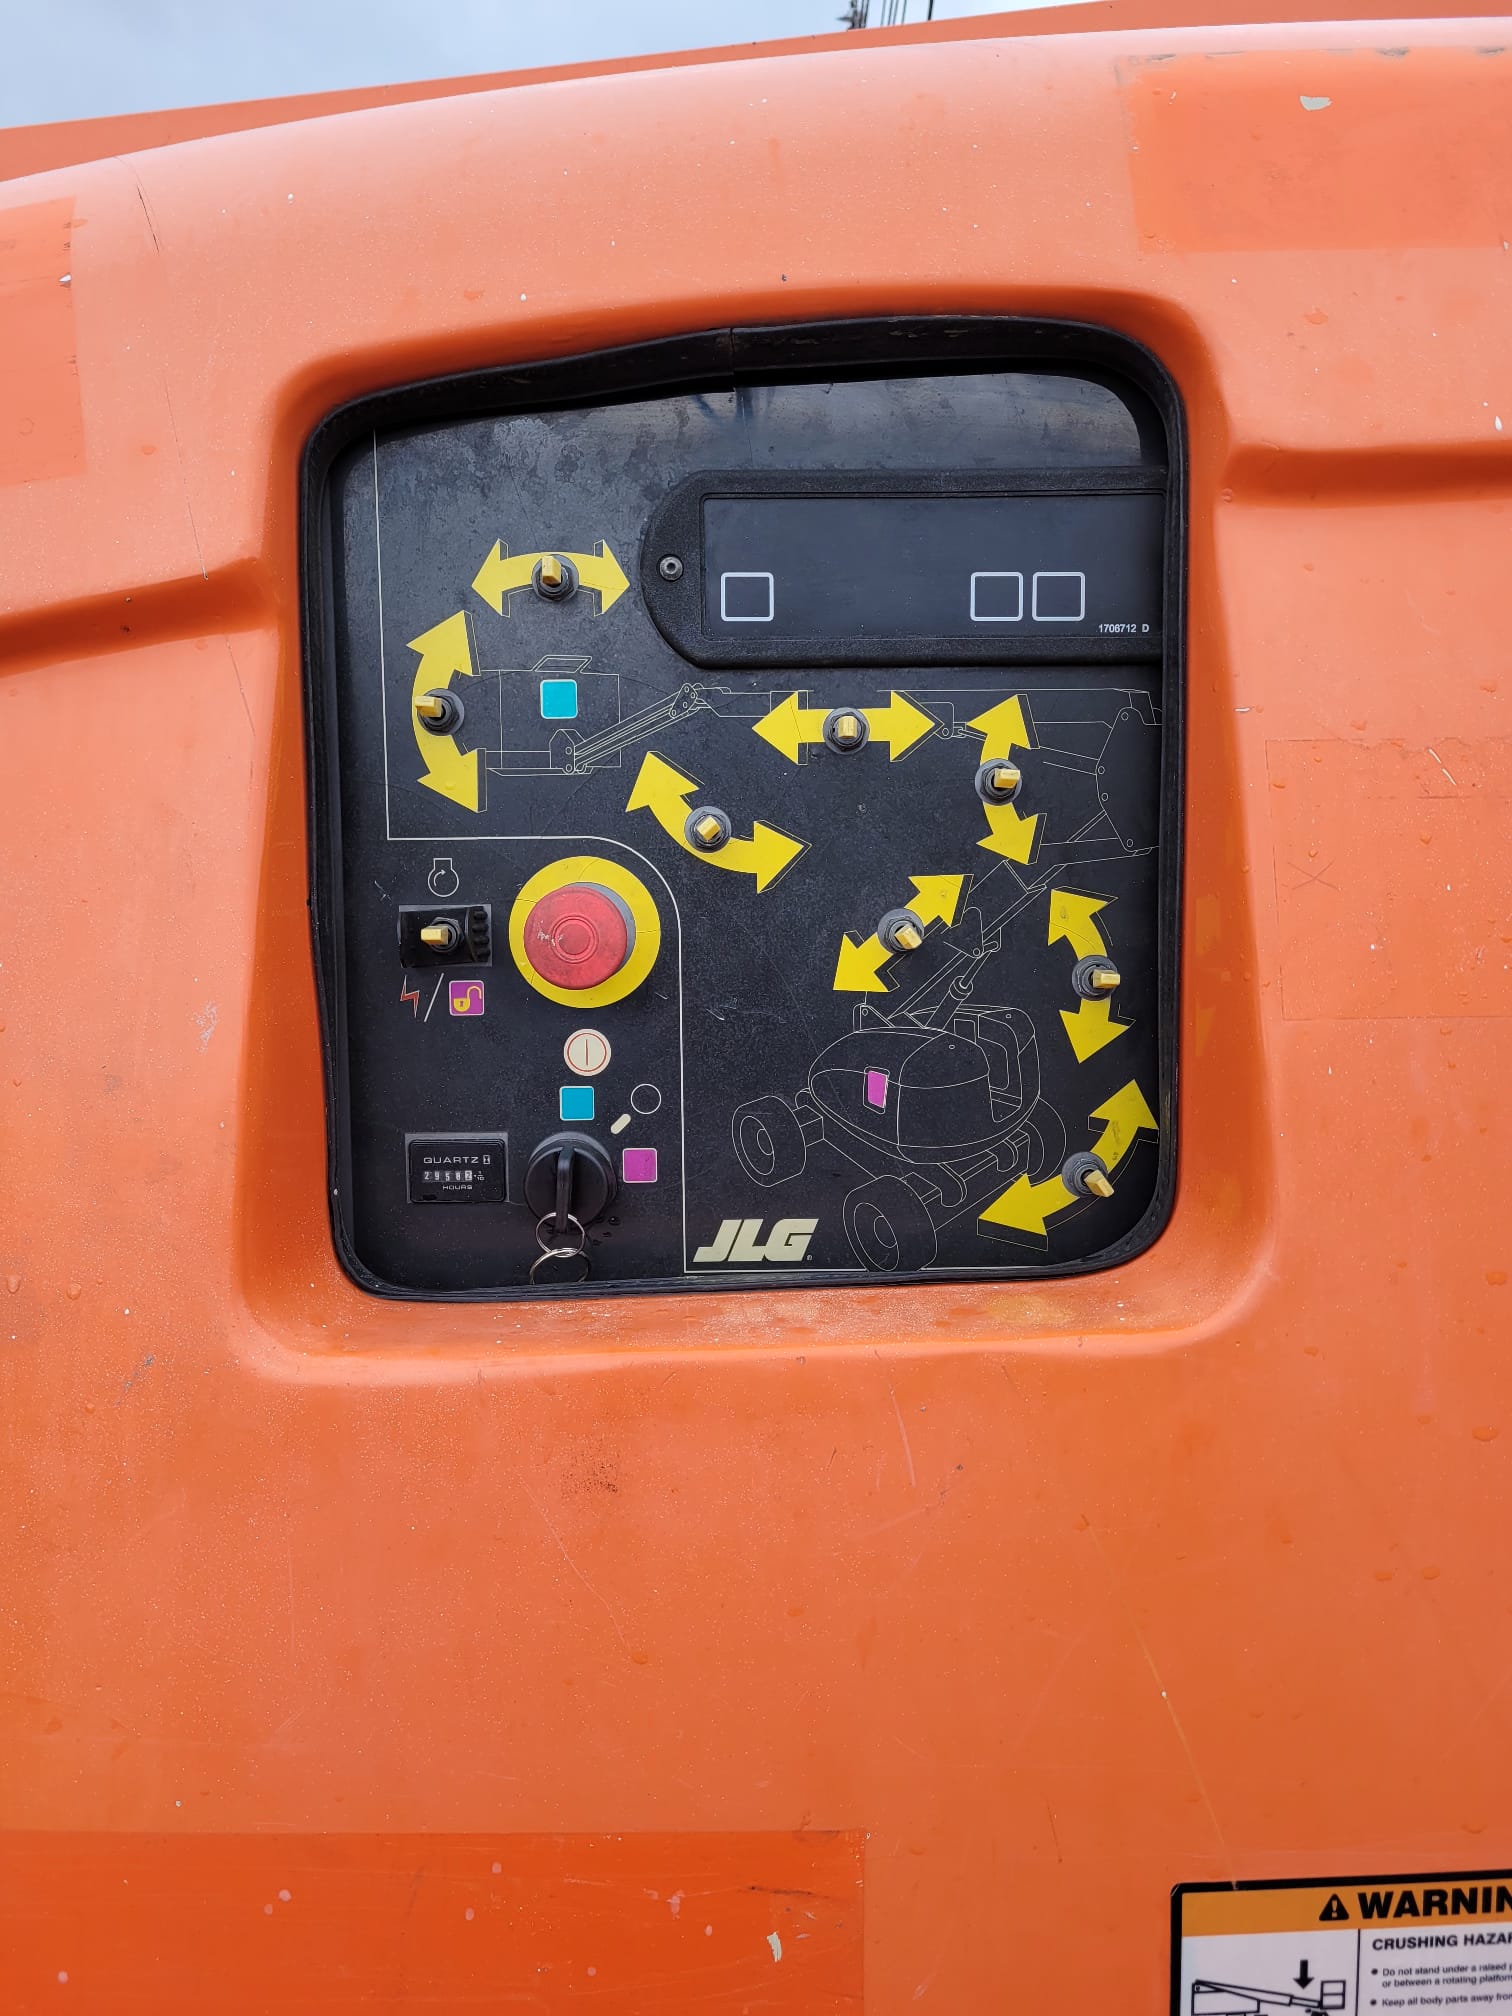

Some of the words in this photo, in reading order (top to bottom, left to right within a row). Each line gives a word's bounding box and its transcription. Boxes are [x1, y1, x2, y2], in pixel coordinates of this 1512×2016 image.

[1098, 623, 1137, 633] 1706712
[1141, 623, 1150, 633] D
[423, 1156, 479, 1164] QUARTZ
[692, 1218, 820, 1263] JLG
[1357, 1886, 1512, 1919] WARNIN
[1372, 1934, 1458, 1951] CRUSHING
[1382, 1968, 1395, 1977] Do
[1398, 1967, 1412, 1976] not
[1415, 1966, 1439, 1975] stand
[1442, 1965, 1468, 1974] under
[1479, 1962, 1506, 1972] raised
[1382, 1980, 1391, 1988] or
[1394, 1978, 1432, 1988] between
[1442, 1975, 1477, 1985] rotating
[1382, 1998, 1405, 2008] Keep
[1407, 1997, 1417, 2006] all
[1420, 1996, 1442, 2007] body
[1445, 1995, 1468, 2005] parts
[1471, 1994, 1493, 2004] away
